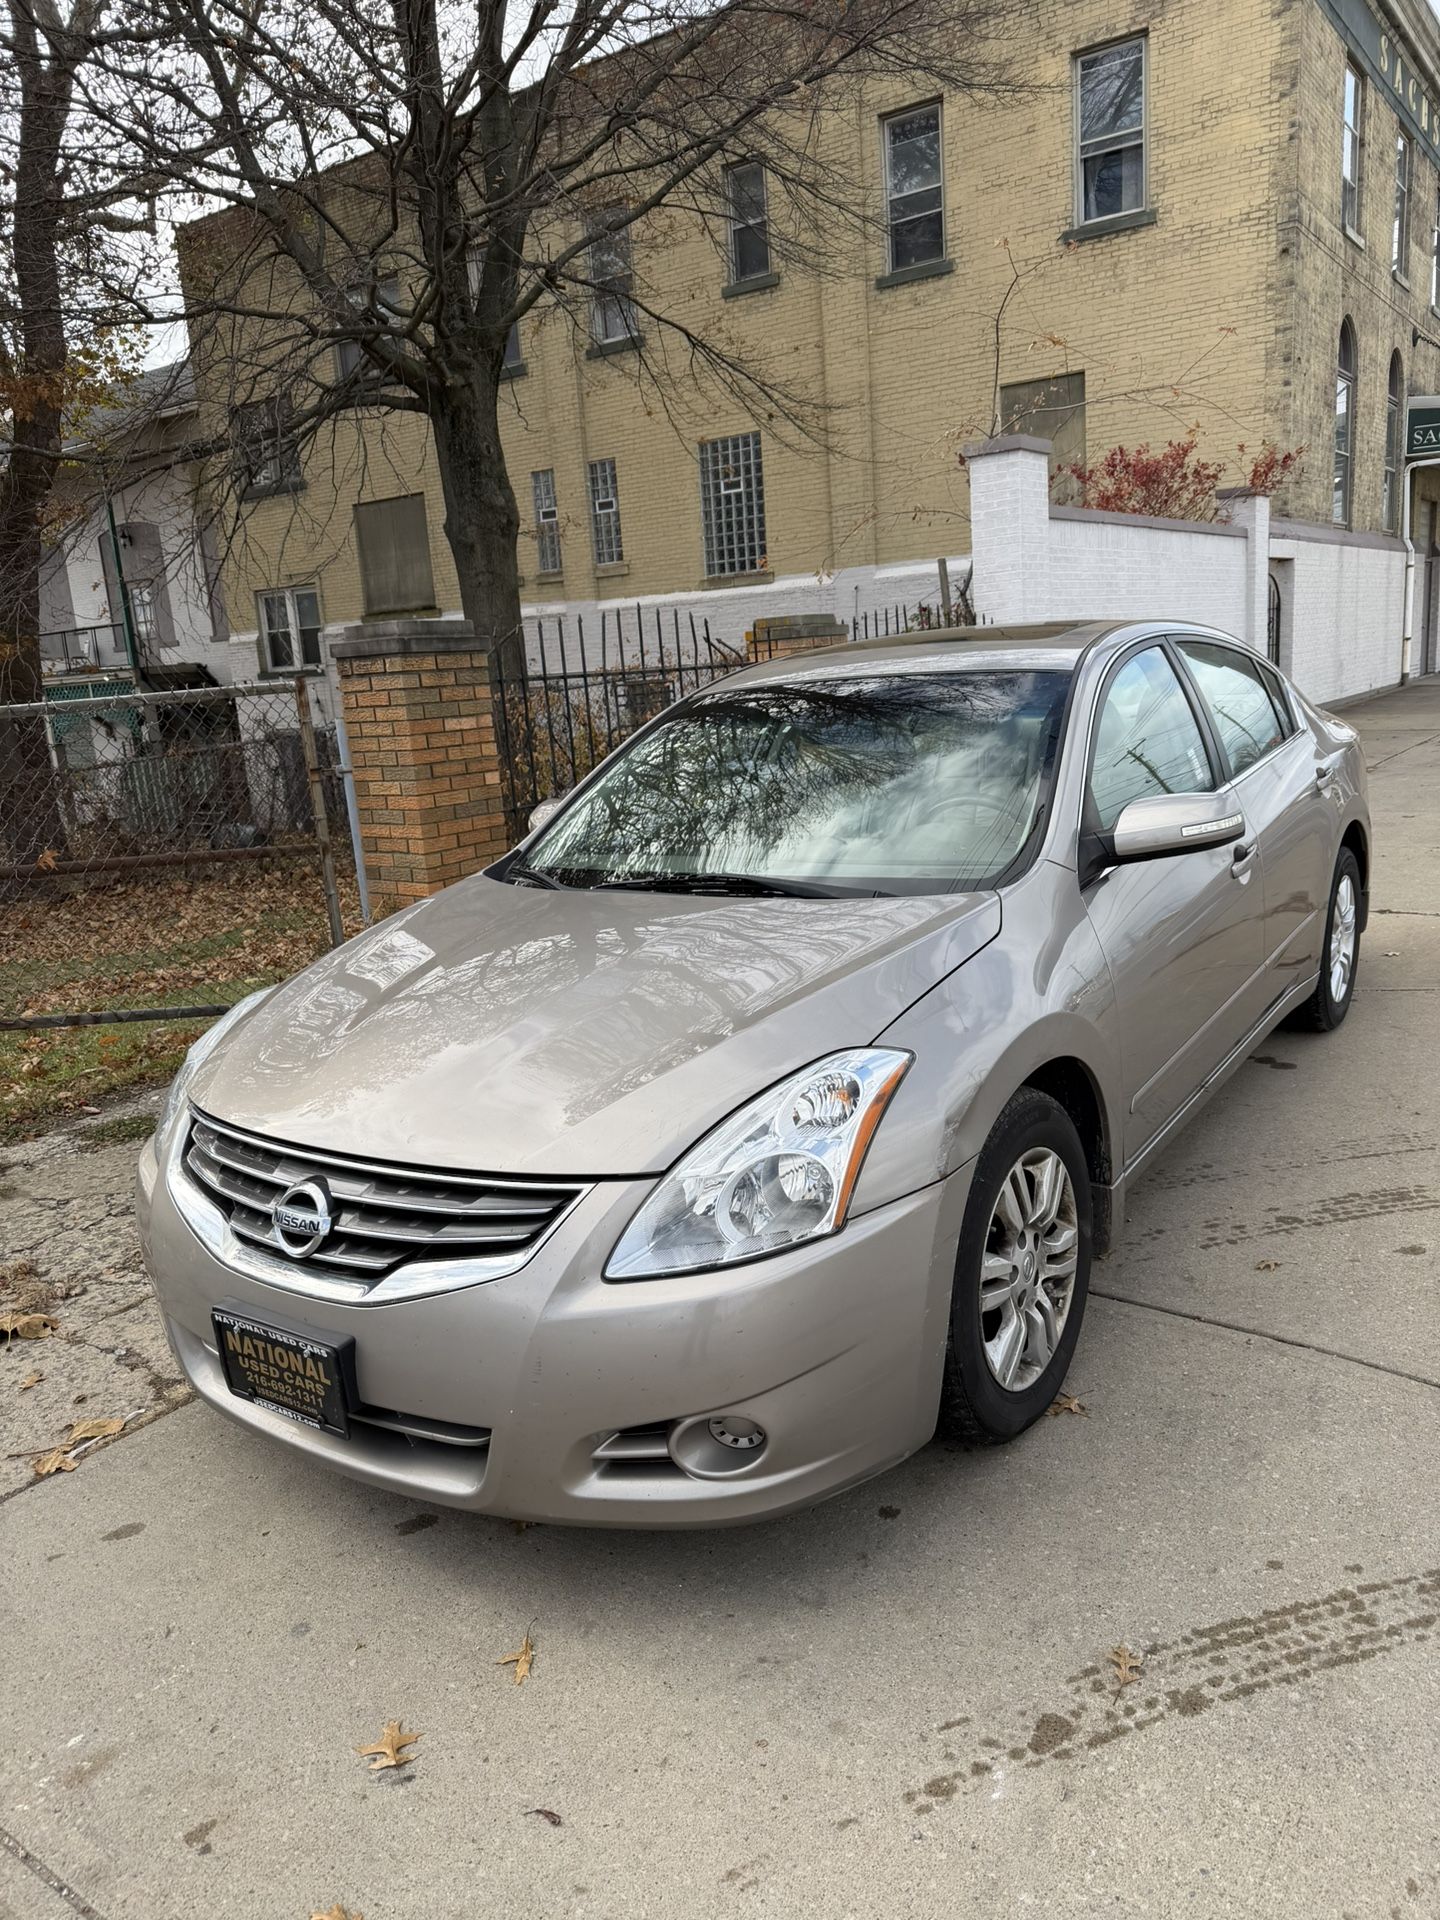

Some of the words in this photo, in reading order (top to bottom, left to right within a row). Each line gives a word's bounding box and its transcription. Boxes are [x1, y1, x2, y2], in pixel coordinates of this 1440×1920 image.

[1380, 34, 1440, 146] SACHS
[1413, 429, 1440, 445] SA
[273, 1210, 320, 1232] NISSAN
[214, 1314, 267, 1336] NATIONAL
[268, 1331, 297, 1346] USED
[299, 1341, 328, 1358] CARS
[226, 1330, 331, 1386] NATIONAL
[238, 1355, 280, 1378] USED
[283, 1371, 325, 1396] CARS
[247, 1371, 323, 1408] 216-692-1311
[253, 1398, 320, 1430] USEDCARS12.com
